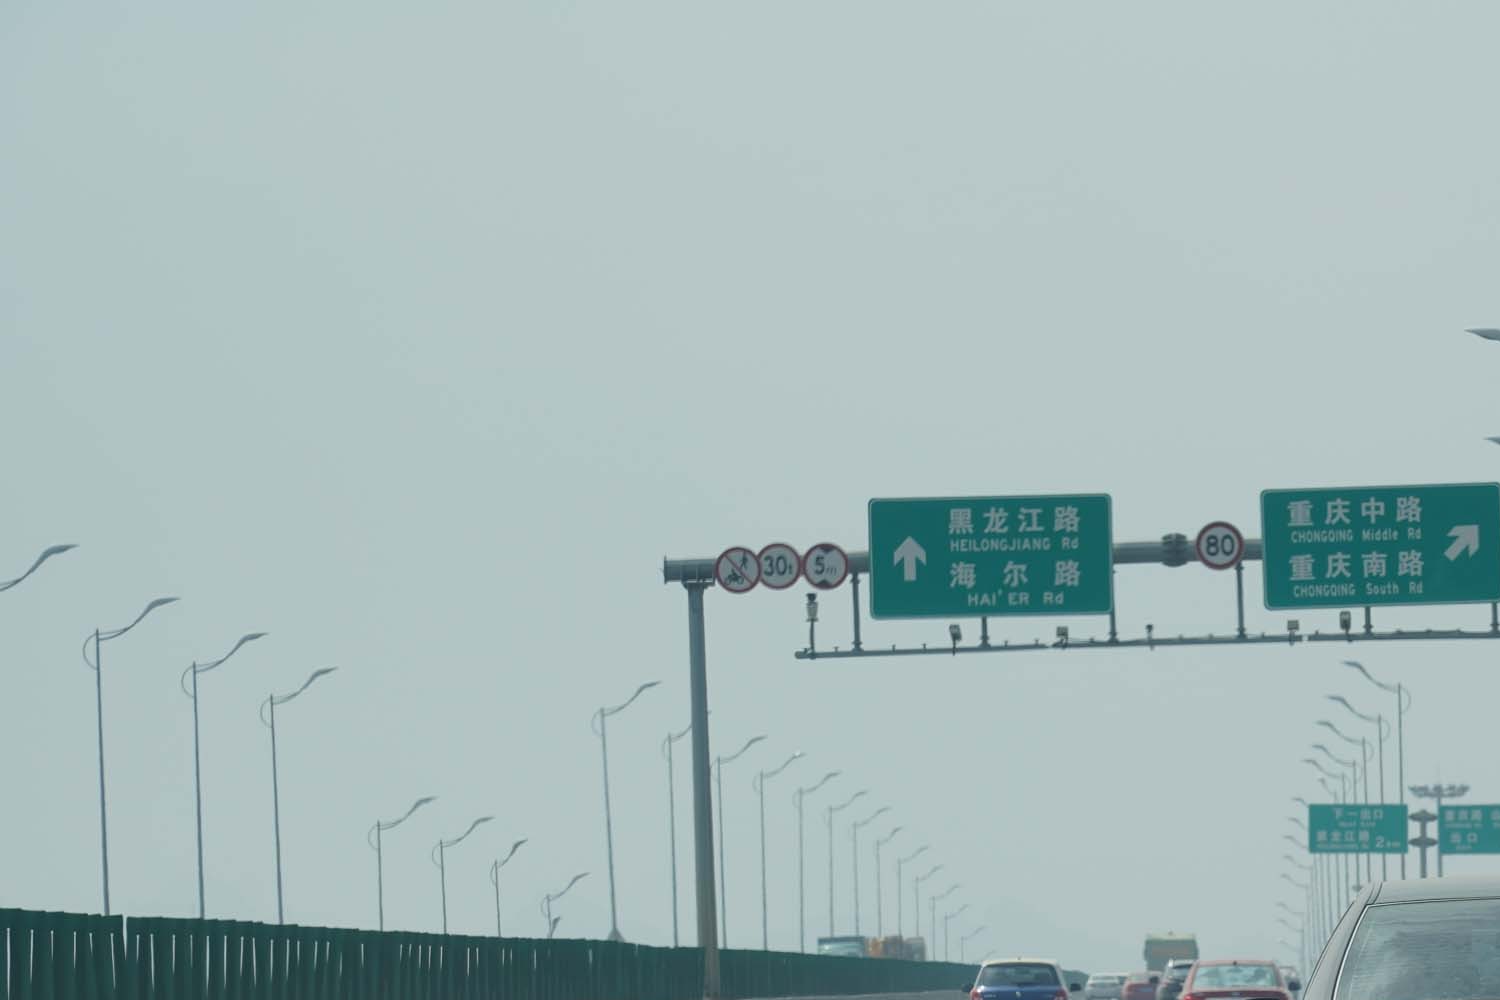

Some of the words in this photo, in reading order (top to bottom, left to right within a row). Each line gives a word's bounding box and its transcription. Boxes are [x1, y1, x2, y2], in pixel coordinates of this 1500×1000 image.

[949, 505, 1080, 534] 黑龙江路
[1287, 496, 1422, 526] 重庆中路
[949, 537, 1051, 552] HEILONGJIANG
[1061, 537, 1079, 550] Rd
[1206, 534, 1234, 557] 80
[1362, 528, 1399, 541] Middle
[1407, 527, 1422, 540] Rd
[949, 559, 1080, 589] 海尔路
[1288, 550, 1424, 581] 重庆南路
[1043, 591, 1065, 606] Rd
[1366, 582, 1399, 595] South
[1409, 581, 1423, 594] Rd
